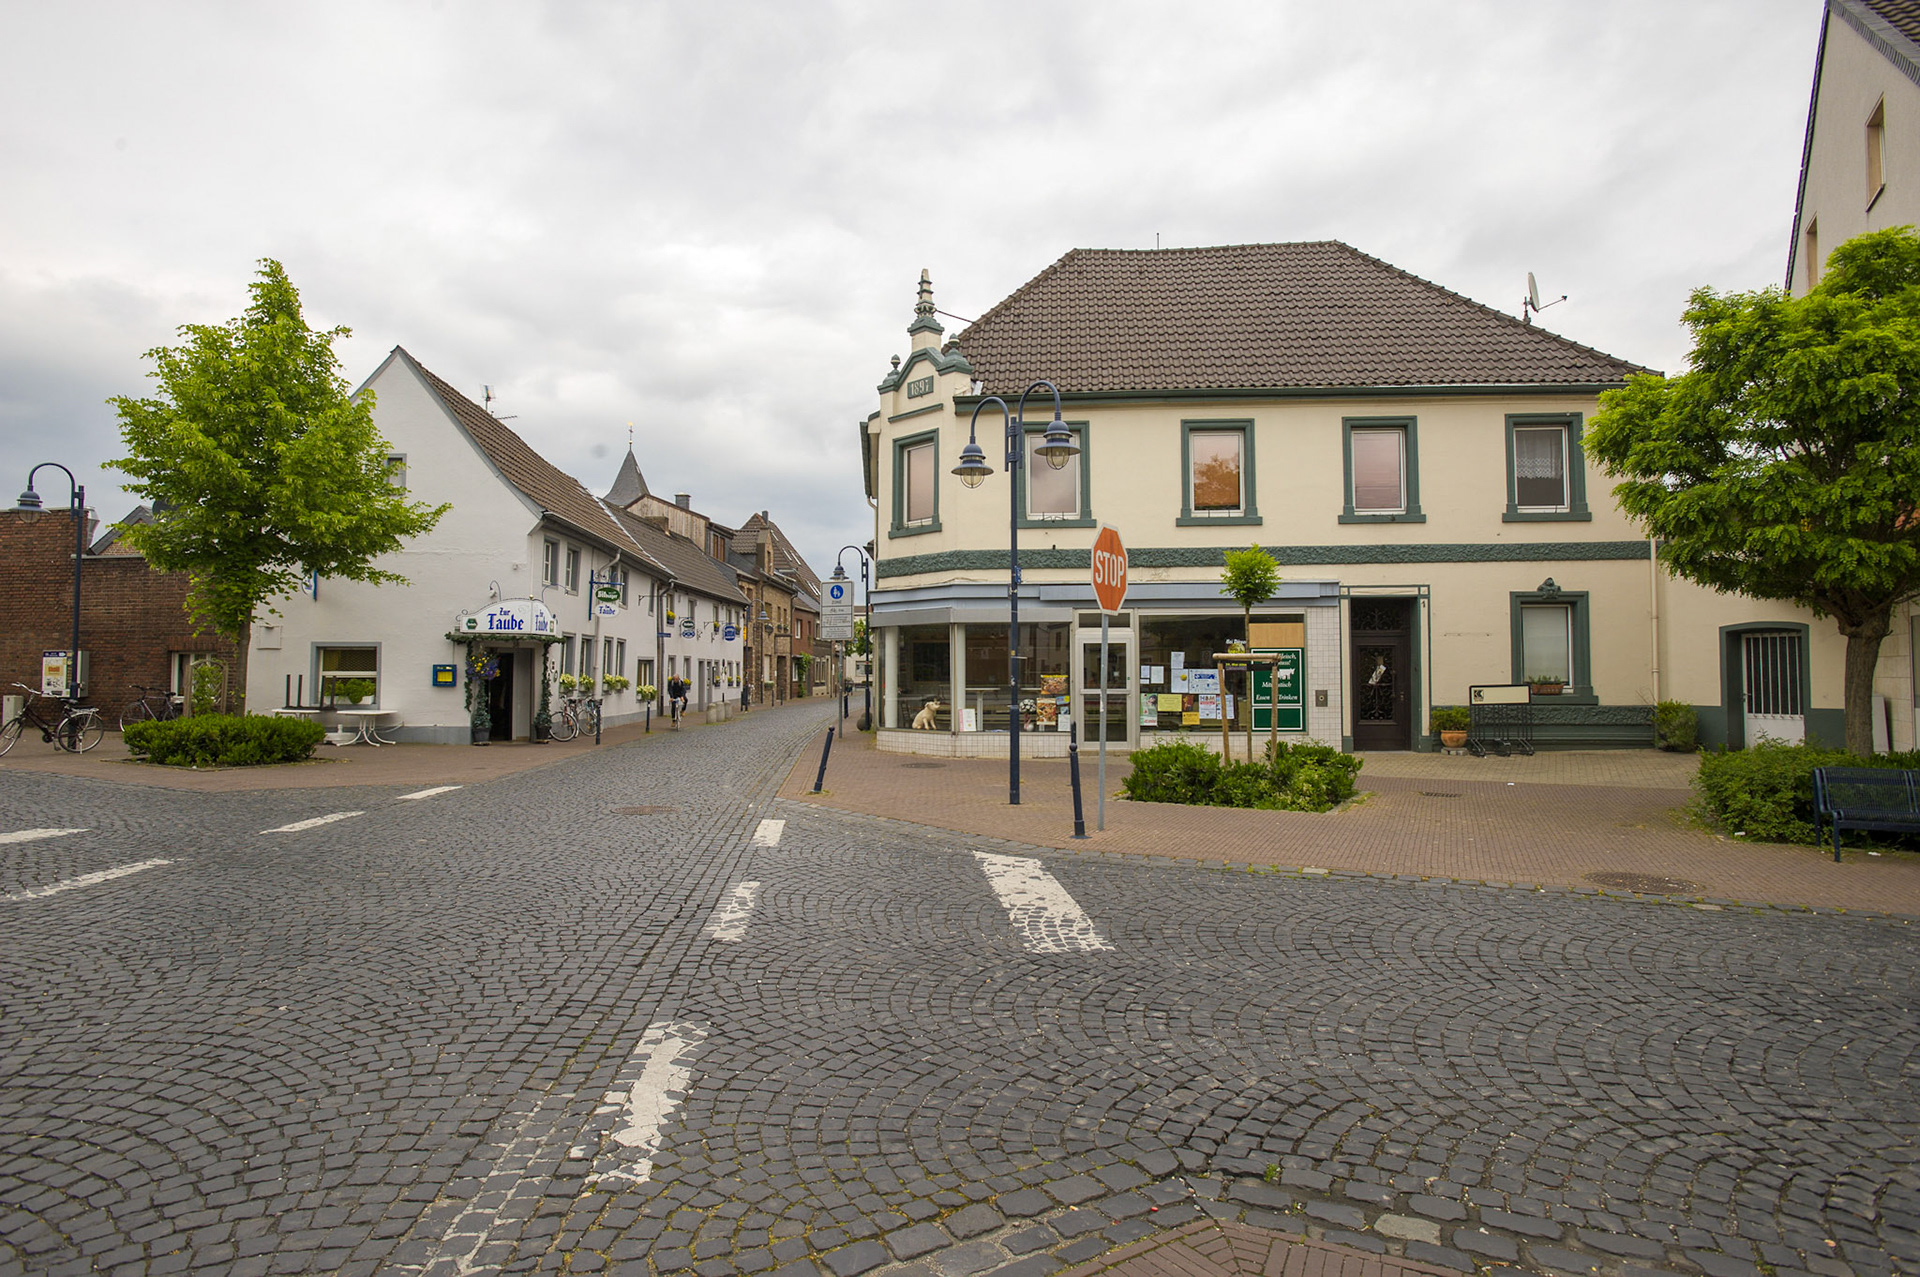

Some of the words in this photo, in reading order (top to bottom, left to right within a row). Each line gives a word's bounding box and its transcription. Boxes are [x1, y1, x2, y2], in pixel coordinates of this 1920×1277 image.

[911, 379, 930, 396] 1897
[1095, 549, 1125, 588] STOP
[499, 607, 511, 616] Zur
[598, 605, 616, 615] Taube
[1421, 600, 1426, 608] 1
[486, 613, 525, 630] Taube
[535, 614, 548, 632] Taube
